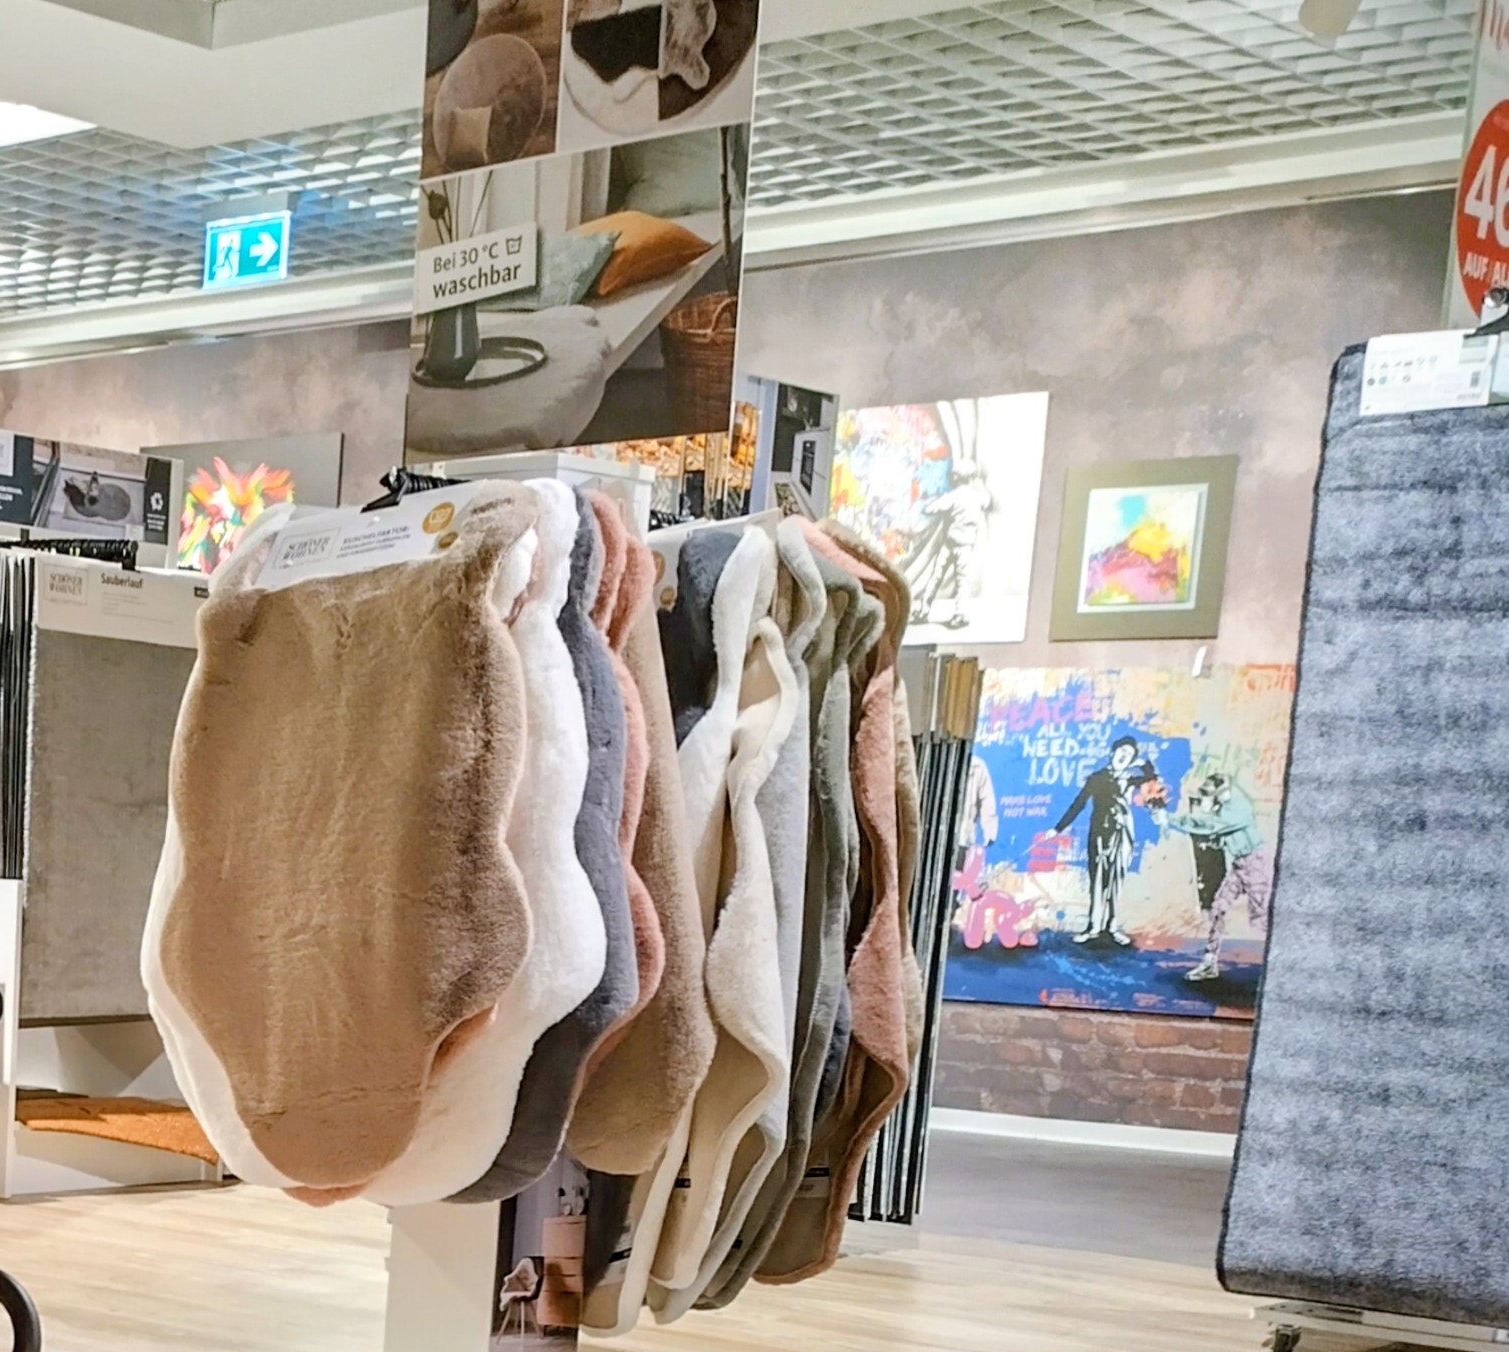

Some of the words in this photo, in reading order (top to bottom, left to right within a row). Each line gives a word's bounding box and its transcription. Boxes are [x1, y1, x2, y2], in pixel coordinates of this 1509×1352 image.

[433, 254, 456, 274] Bei
[459, 248, 479, 267] 30
[433, 264, 521, 299] waschbar
[101, 573, 144, 589] Sauberlauf
[1078, 722, 1112, 741] YOU
[1022, 735, 1078, 758] NEED
[1028, 758, 1098, 788] LOVE
[1003, 806, 1024, 818] NOT
